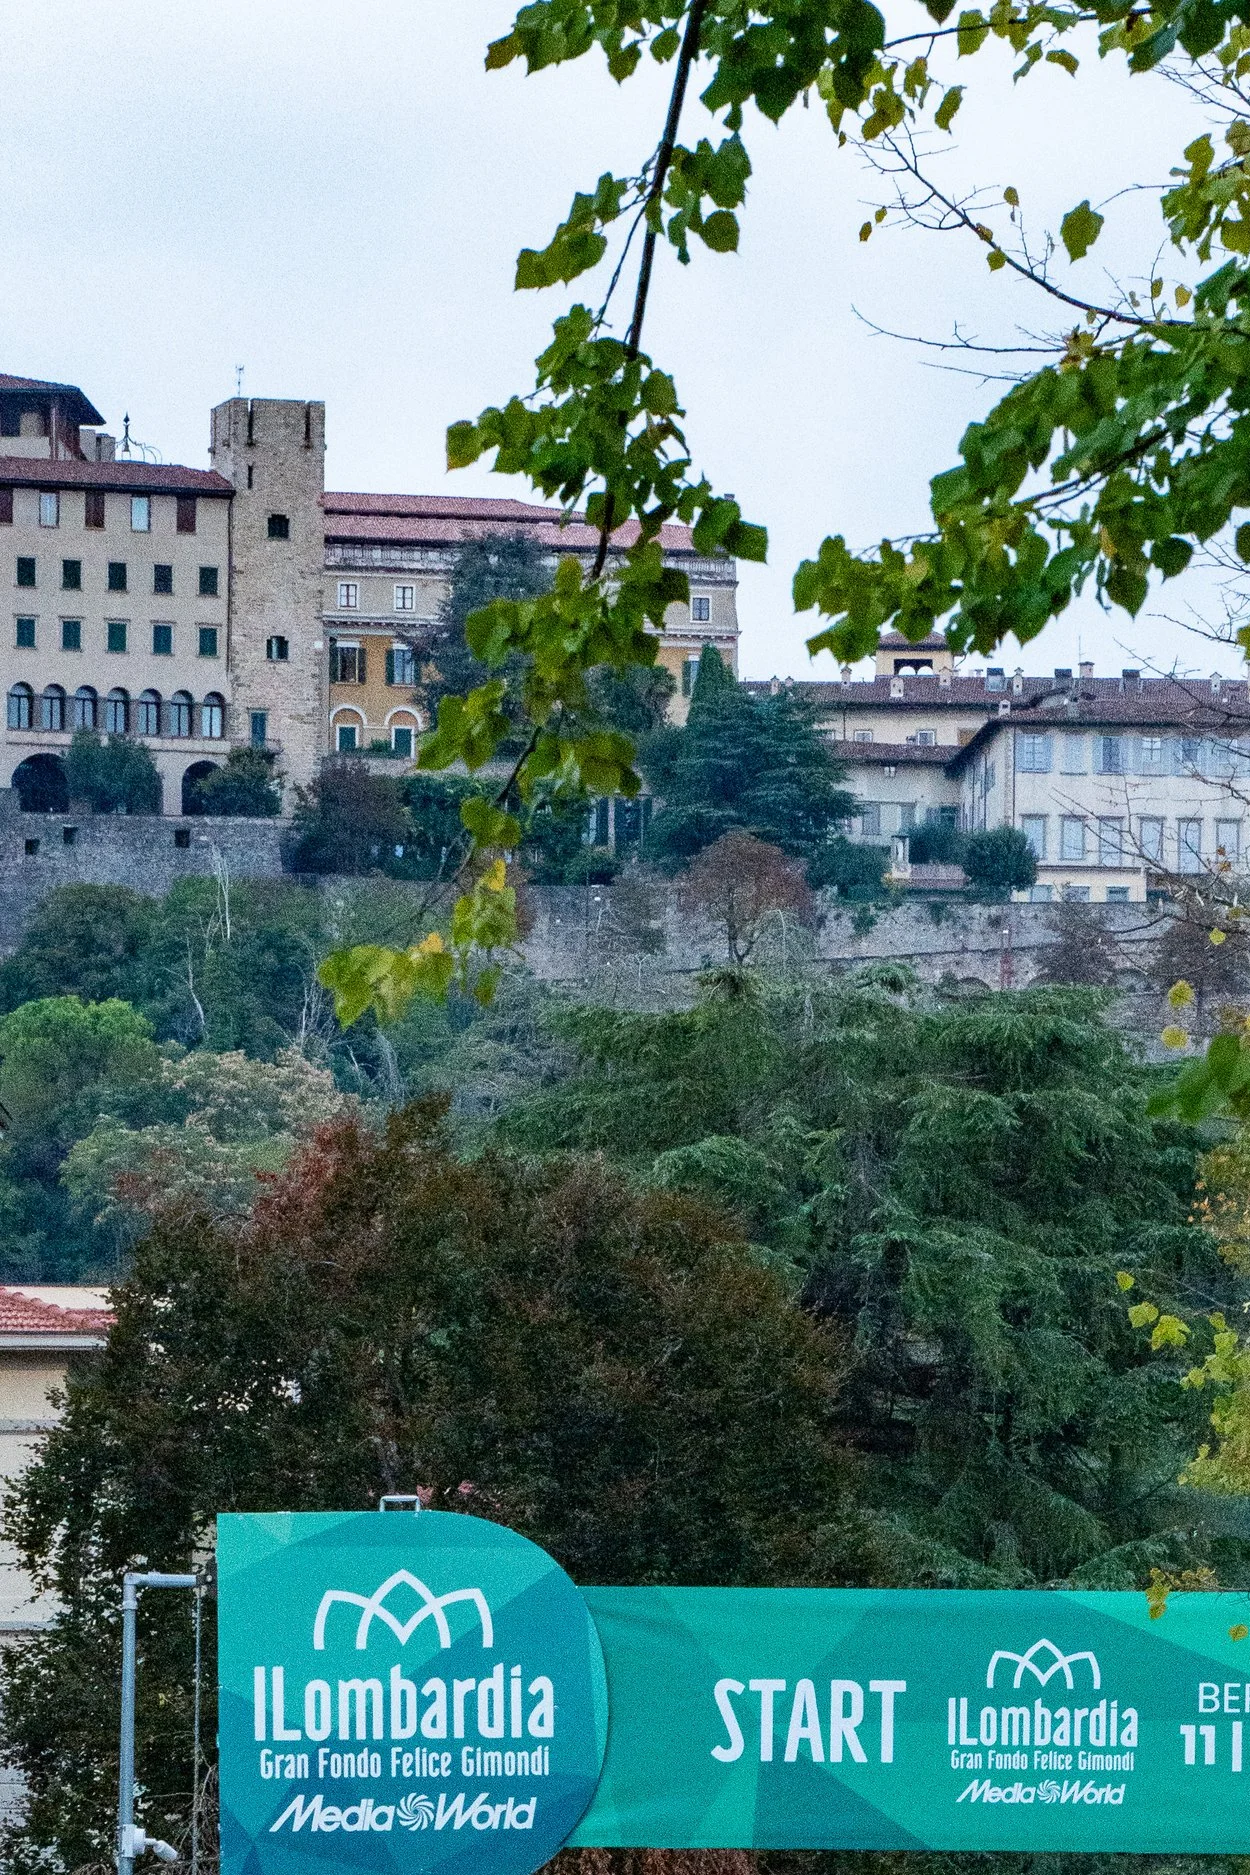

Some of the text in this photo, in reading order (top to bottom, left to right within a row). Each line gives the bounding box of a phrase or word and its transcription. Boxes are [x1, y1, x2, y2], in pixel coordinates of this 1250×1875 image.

[253, 1662, 555, 1742] ILombardia
[710, 1677, 907, 1763] START
[947, 1697, 1139, 1747] ILombardia
[260, 1745, 550, 1779] Gran Fondo Felice Gimondi
[950, 1750, 1135, 1772] Gran Fondo Felice Gimondi
